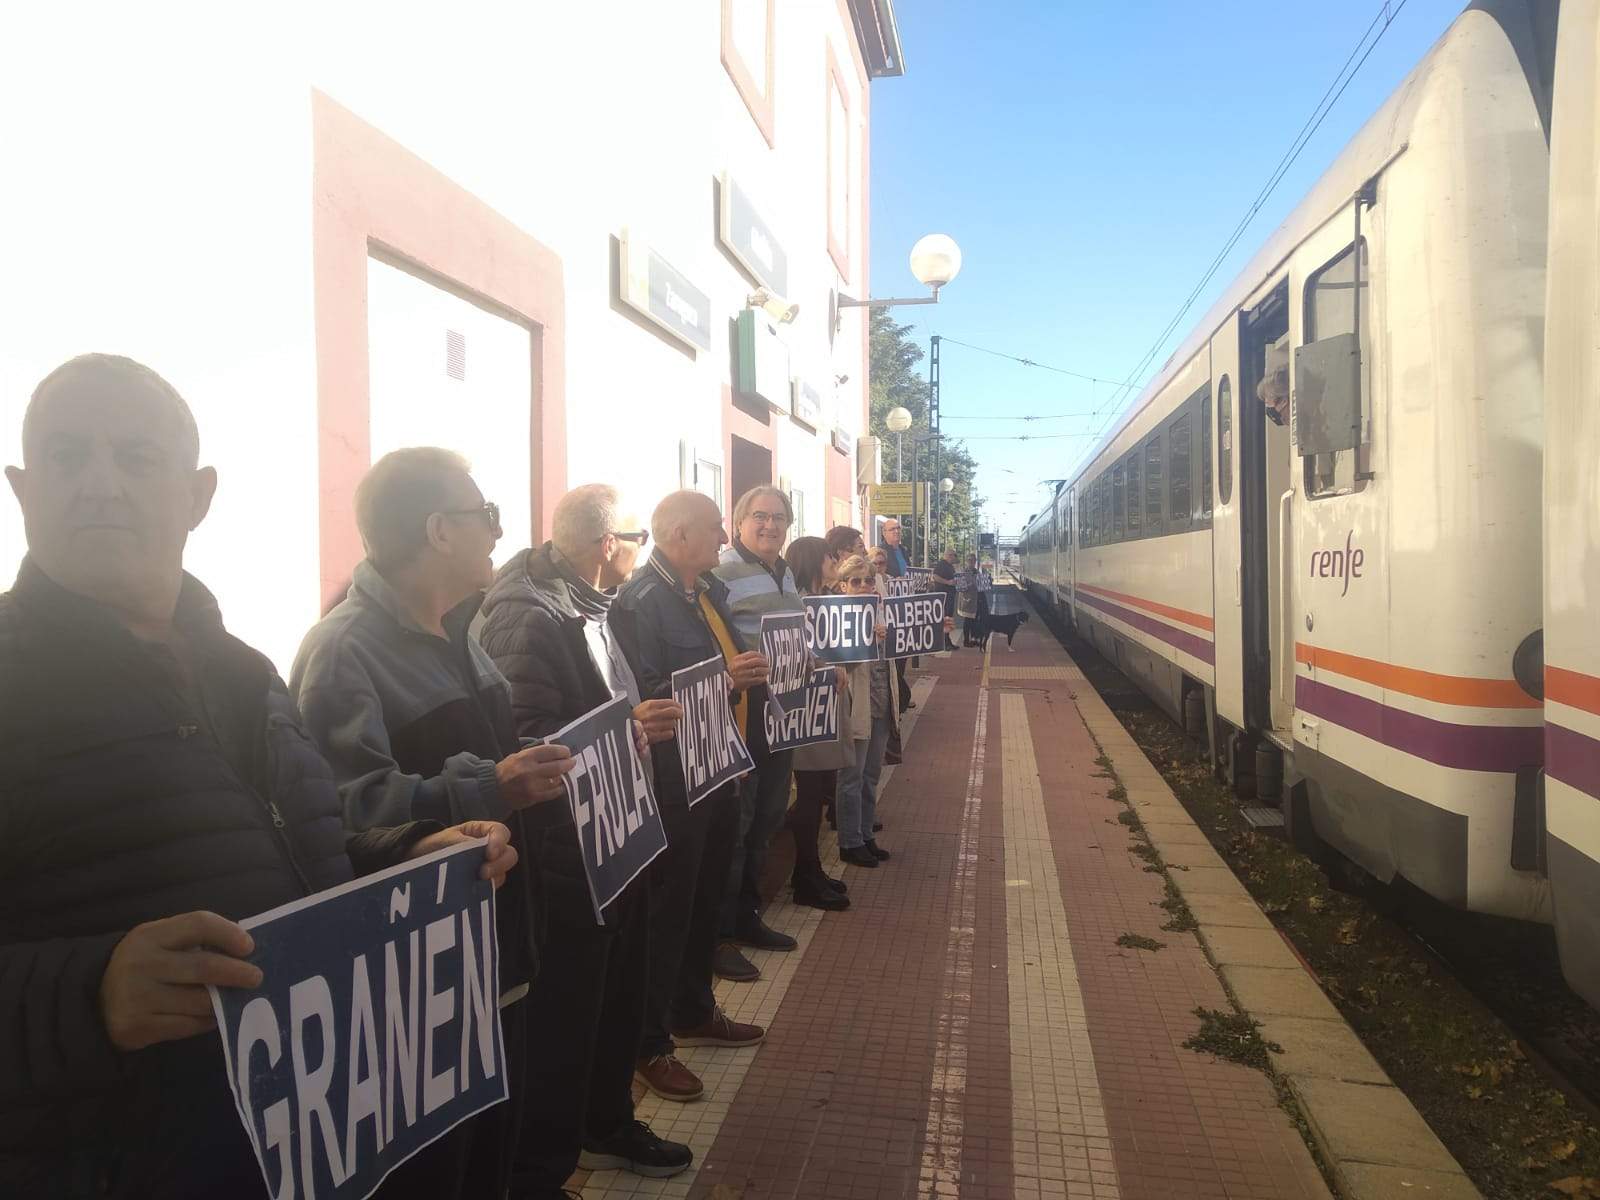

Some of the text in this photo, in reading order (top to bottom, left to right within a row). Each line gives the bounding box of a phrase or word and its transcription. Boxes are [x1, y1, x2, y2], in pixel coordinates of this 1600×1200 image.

[1311, 529, 1364, 598] renfe
[805, 603, 875, 650] SODETO
[885, 598, 943, 628] ALBERO
[895, 625, 933, 653] BAJO
[568, 718, 654, 868] FRULA
[237, 861, 496, 1200] GRAÑÉN
